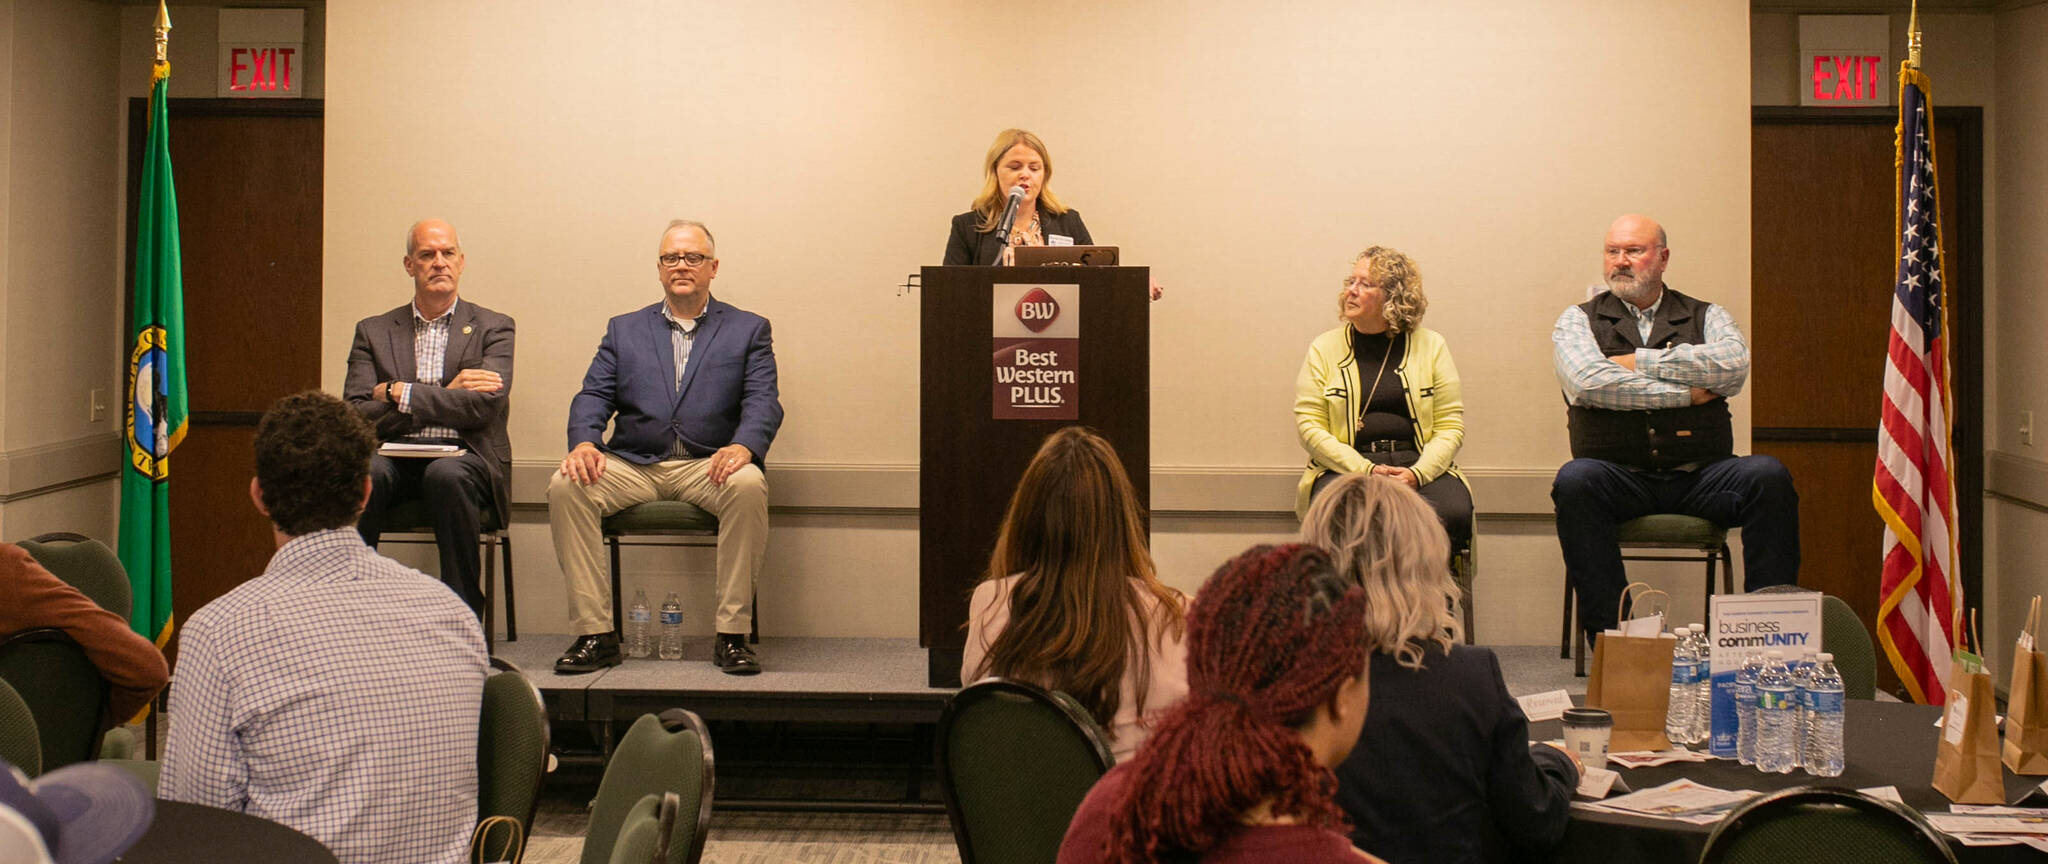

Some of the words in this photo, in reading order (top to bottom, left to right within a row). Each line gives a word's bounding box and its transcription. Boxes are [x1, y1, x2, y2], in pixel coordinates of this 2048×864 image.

[230, 48, 296, 92] EXIT
[1813, 55, 1882, 100] EXIT
[1021, 302, 1055, 319] BW
[1015, 349, 1058, 366] Best
[996, 366, 1075, 384] Western
[1719, 619, 1780, 633] business
[1719, 632, 1809, 647] commUNITY
